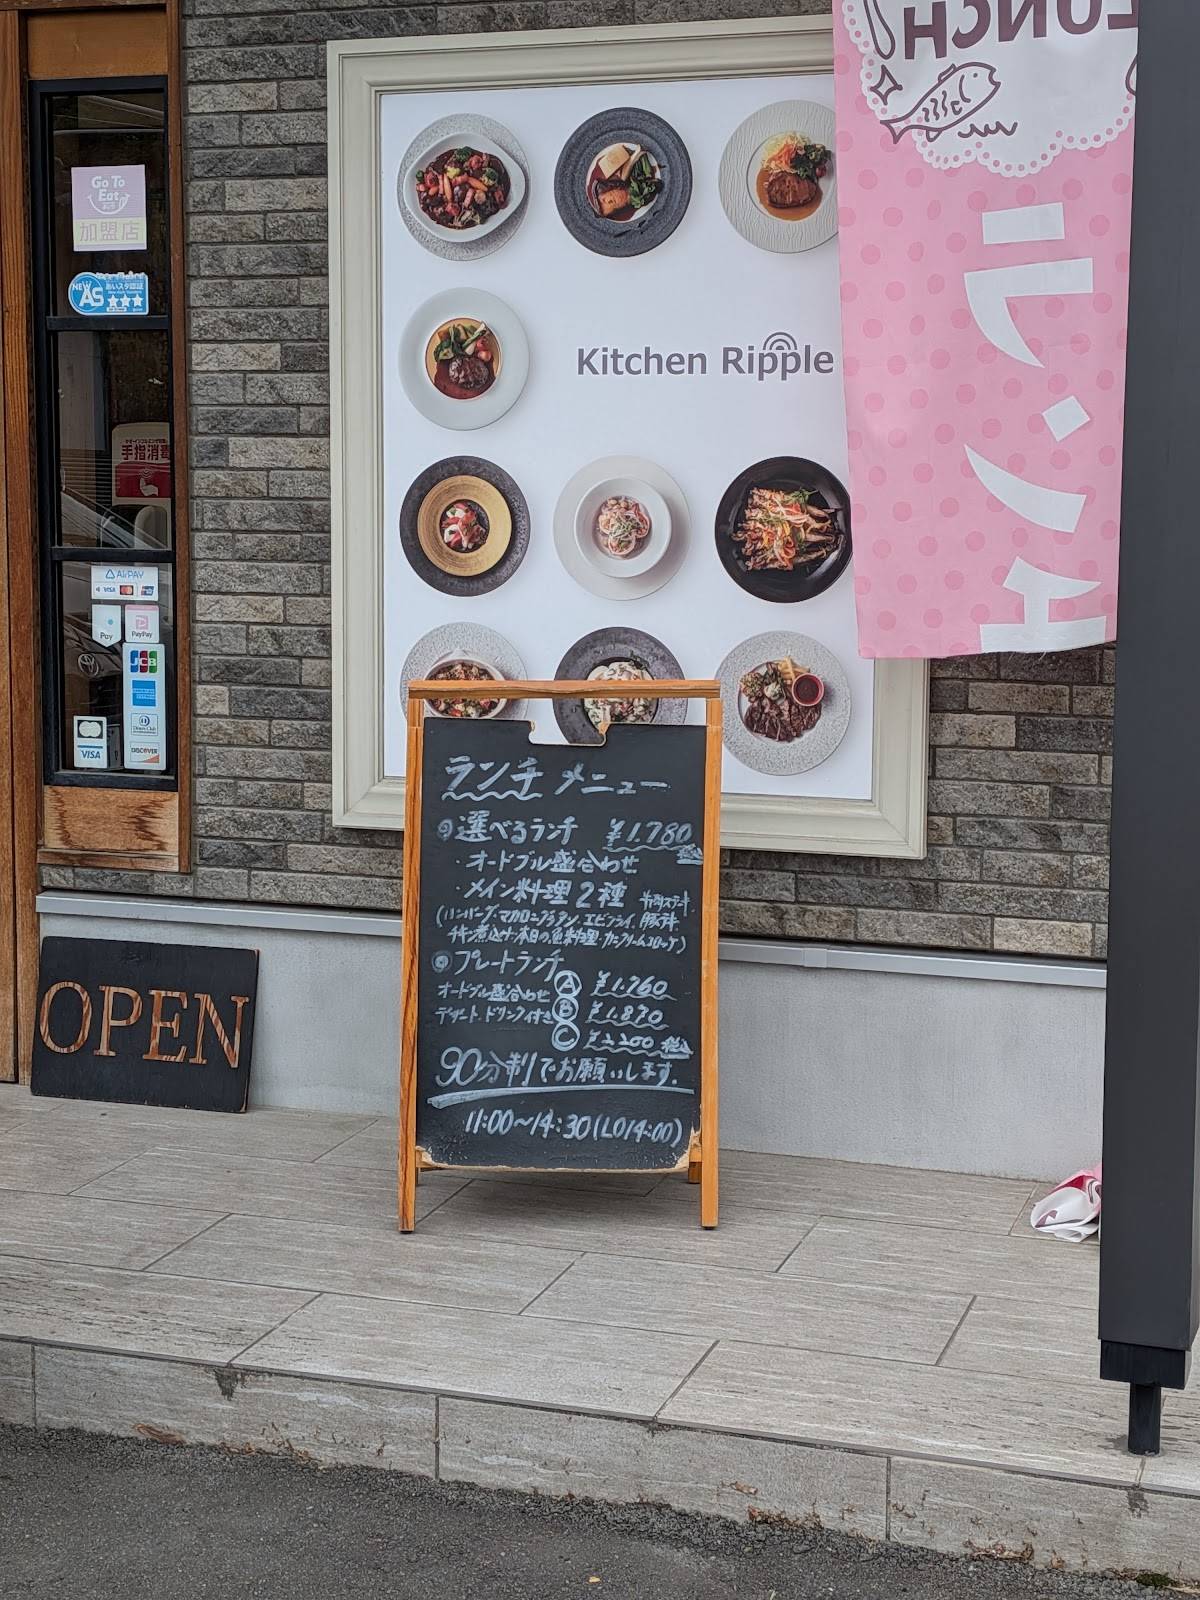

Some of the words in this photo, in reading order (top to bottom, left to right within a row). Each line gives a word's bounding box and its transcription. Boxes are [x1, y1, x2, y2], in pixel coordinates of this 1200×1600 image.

[92, 175, 109, 189] Go
[111, 175, 125, 189] To
[99, 188, 120, 202] Eat
[80, 221, 140, 242] 加盟店
[577, 346, 707, 376] Kitchen
[722, 344, 834, 381] Ripple
[131, 630, 153, 639] PayPay
[130, 654, 158, 670] JCB
[82, 750, 101, 759] VISA
[445, 755, 544, 797] ランチ
[554, 763, 669, 796] メニュー
[40, 981, 249, 1069] OPEN
